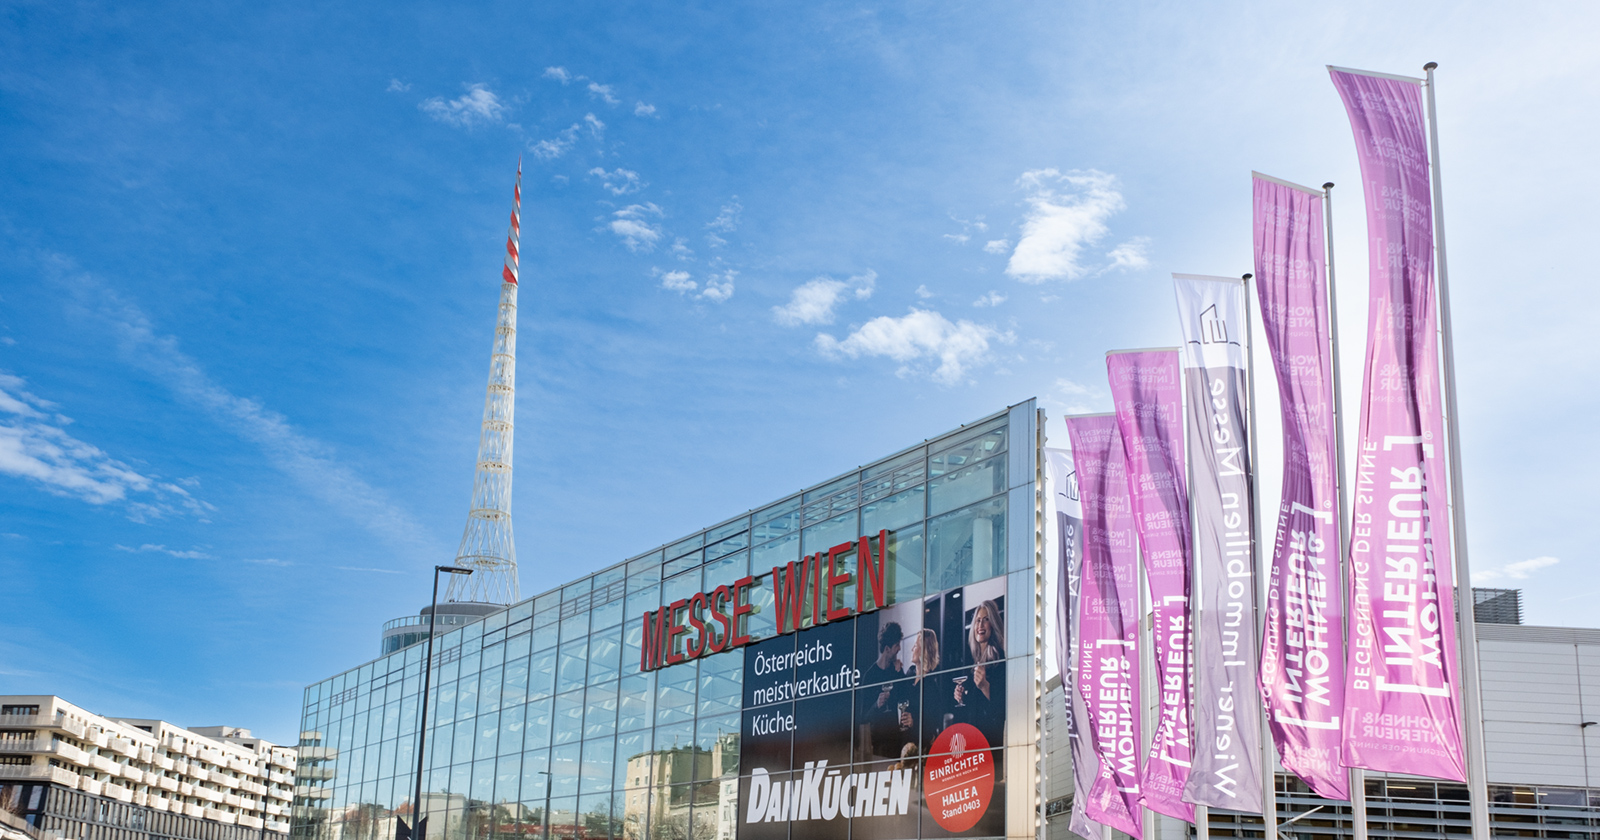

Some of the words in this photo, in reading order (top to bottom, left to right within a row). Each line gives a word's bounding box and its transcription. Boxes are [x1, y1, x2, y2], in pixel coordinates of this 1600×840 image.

[640, 575, 756, 672] MESSE
[772, 529, 890, 636] WIEN
[754, 639, 833, 676] Österreichs
[753, 664, 861, 706] meistverkaufte
[752, 710, 798, 737] Küche.
[929, 752, 985, 781] EINRICHTER
[942, 788, 970, 807] HALLE
[971, 785, 978, 798] A
[942, 804, 963, 819] Stand
[962, 798, 981, 813] 0403
